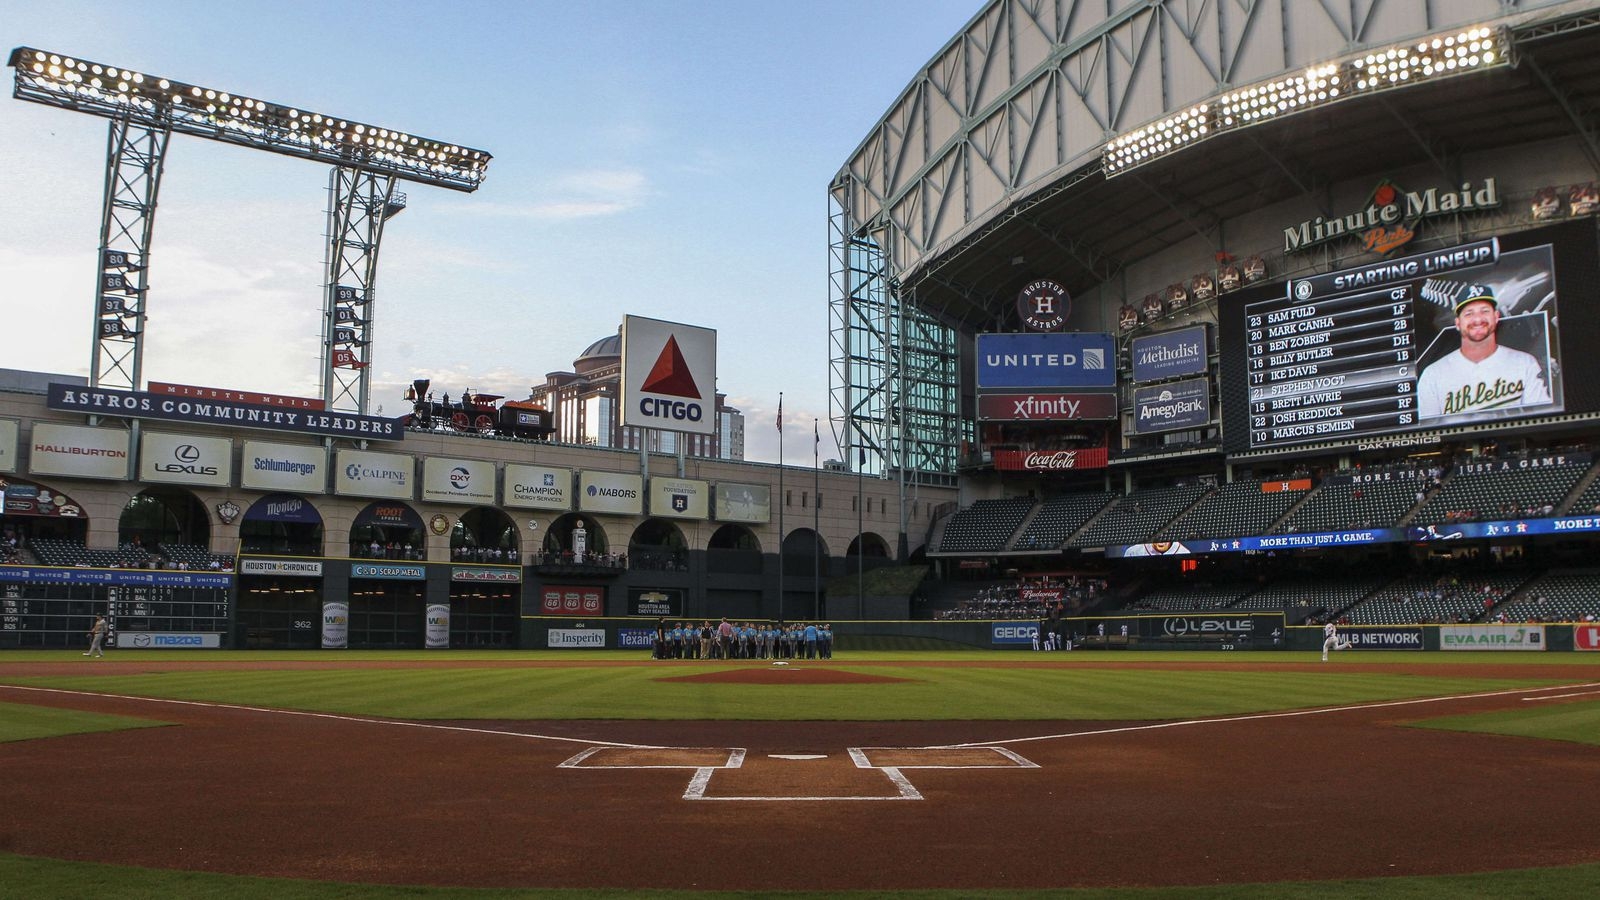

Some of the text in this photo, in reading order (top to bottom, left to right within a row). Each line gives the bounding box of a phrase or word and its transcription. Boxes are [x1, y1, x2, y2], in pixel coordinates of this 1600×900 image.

[1284, 178, 1499, 252] Minute Maid
[109, 255, 124, 264] 80
[1334, 246, 1490, 290] STARTING LINEUP
[107, 278, 122, 287] 86
[1024, 281, 1064, 296] HOUSTON
[340, 290, 352, 299] 99
[1391, 289, 1406, 300] CF
[106, 301, 120, 310] 97
[1035, 296, 1054, 314] H
[1393, 304, 1406, 315] LF
[1026, 316, 1062, 328] ASTROS
[1250, 306, 1316, 327] 23 SAM FULD
[104, 324, 118, 332] 98
[1252, 317, 1334, 341] 20 MARK CANHA
[1394, 320, 1407, 330] 2B
[338, 332, 350, 340] 04
[1393, 335, 1410, 346] DH
[1253, 332, 1331, 355] 18 BEN ZOBRIST
[337, 354, 350, 362] 05
[987, 354, 1077, 366] UNITED
[1138, 343, 1199, 365] Methodist
[1254, 347, 1334, 369] 16 BILLY BUTLER
[1397, 351, 1409, 361] 1B
[1176, 357, 1199, 365] MEDICINE
[1254, 365, 1318, 384] 17 IKE DAVIS
[1399, 367, 1408, 376] C
[1254, 375, 1345, 398] 21 STEPHEN VOGT
[1398, 382, 1411, 393] 3B
[168, 386, 244, 400] MINUTE
[1442, 376, 1525, 414] Athletics
[1272, 391, 1342, 410] BRETT LAWRIE
[1398, 397, 1412, 409] RF
[640, 397, 702, 422] CITGO
[1014, 396, 1080, 418] xfinity
[1140, 399, 1203, 419] AmegyBank
[162, 400, 298, 425] COMMUNITY
[306, 415, 392, 434] LEADERS
[1255, 406, 1343, 427] 22 JOSH REDDICK
[1399, 413, 1412, 424] SS
[1257, 420, 1355, 442] 10 MARCUS SEMIEN
[1358, 436, 1441, 450] DAKTRONICS
[34, 444, 126, 458] HALLIBURTON
[154, 463, 218, 476] LEXUS
[254, 457, 316, 476] Schlumberger
[1353, 472, 1391, 483] MORE
[1460, 463, 1492, 475] JUST
[1502, 462, 1510, 470] A
[362, 469, 406, 480] CALPINE
[450, 474, 470, 482] OXY
[514, 484, 563, 496] CHAMPION
[1281, 482, 1289, 491] H
[599, 488, 636, 498] NABORS
[267, 500, 302, 516] Montejo
[376, 507, 405, 516] ROOT
[1554, 519, 1592, 529] MORE
[1260, 539, 1288, 547] MORE
[1289, 536, 1313, 545] THAN
[1315, 535, 1334, 545] JUST
[1335, 534, 1342, 542] A
[245, 562, 277, 570] HOUSTON
[1022, 590, 1060, 599] Budweiser
[294, 621, 312, 629] 362
[1190, 620, 1254, 631] LEXUS
[562, 632, 604, 645] Insperity
[995, 627, 1038, 638] GEICO
[1362, 632, 1420, 644] NETWORK
[154, 636, 203, 645] mazda
[1444, 634, 1507, 644] EVA AIR
